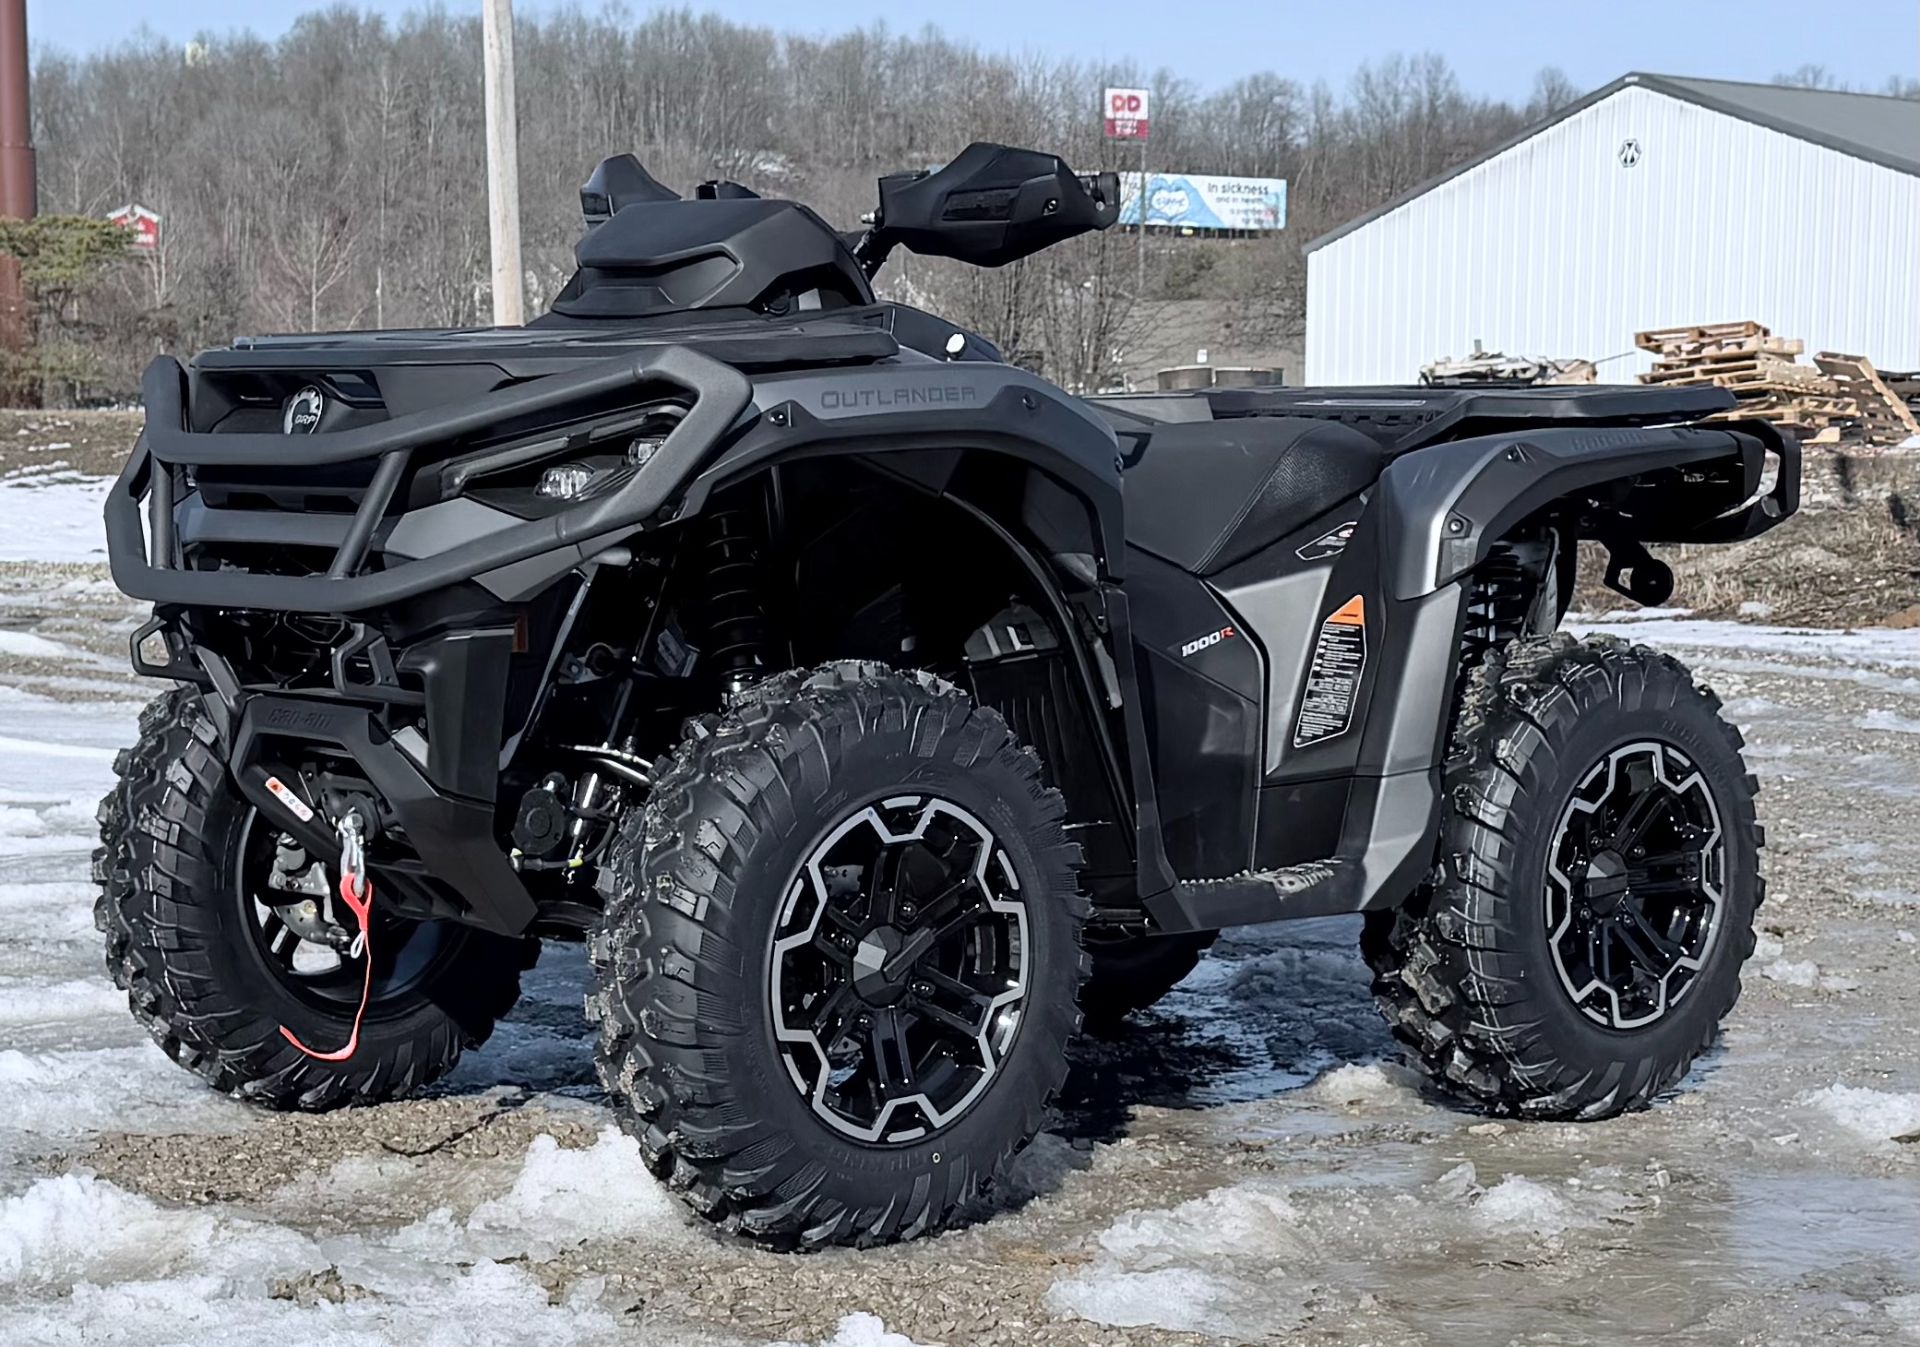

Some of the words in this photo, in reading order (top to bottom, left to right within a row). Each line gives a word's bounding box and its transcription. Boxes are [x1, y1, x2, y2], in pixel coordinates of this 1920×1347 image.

[1207, 182, 1218, 193] In
[1221, 182, 1269, 196] sickness
[820, 386, 977, 409] OUTLANDER
[1181, 626, 1236, 657] 1000R
